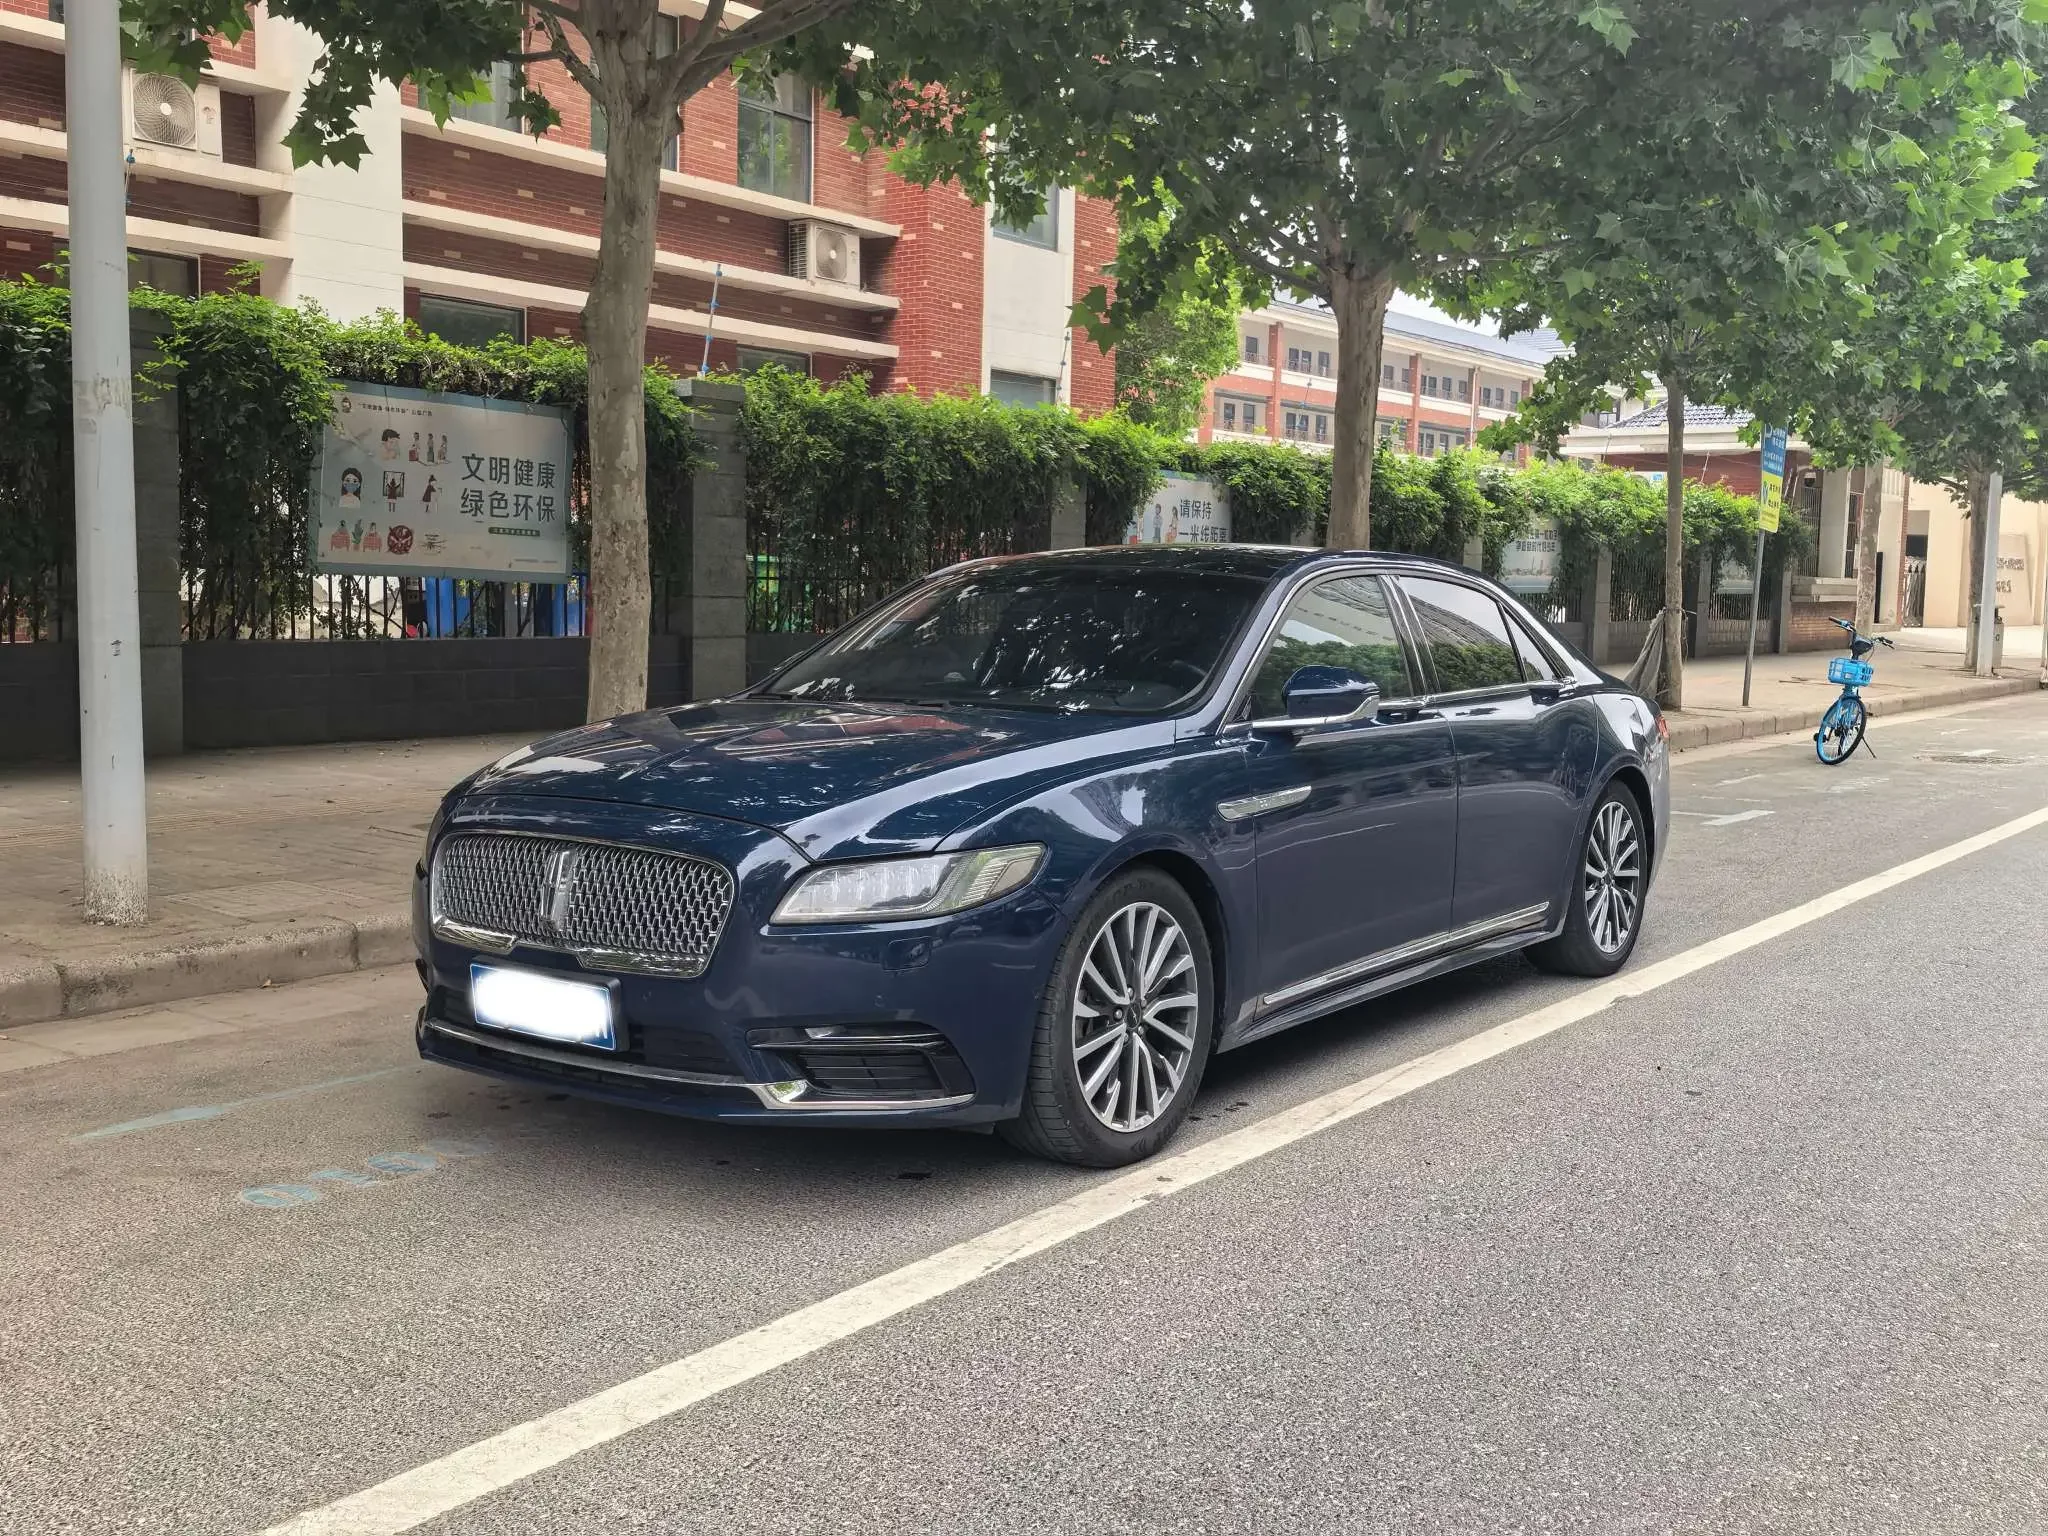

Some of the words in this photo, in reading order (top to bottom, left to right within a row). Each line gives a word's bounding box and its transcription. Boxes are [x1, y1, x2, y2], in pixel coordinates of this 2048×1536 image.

[461, 453, 556, 489] 文明健康
[460, 487, 556, 522] 绿色环保
[1179, 499, 1212, 520] 请保持
